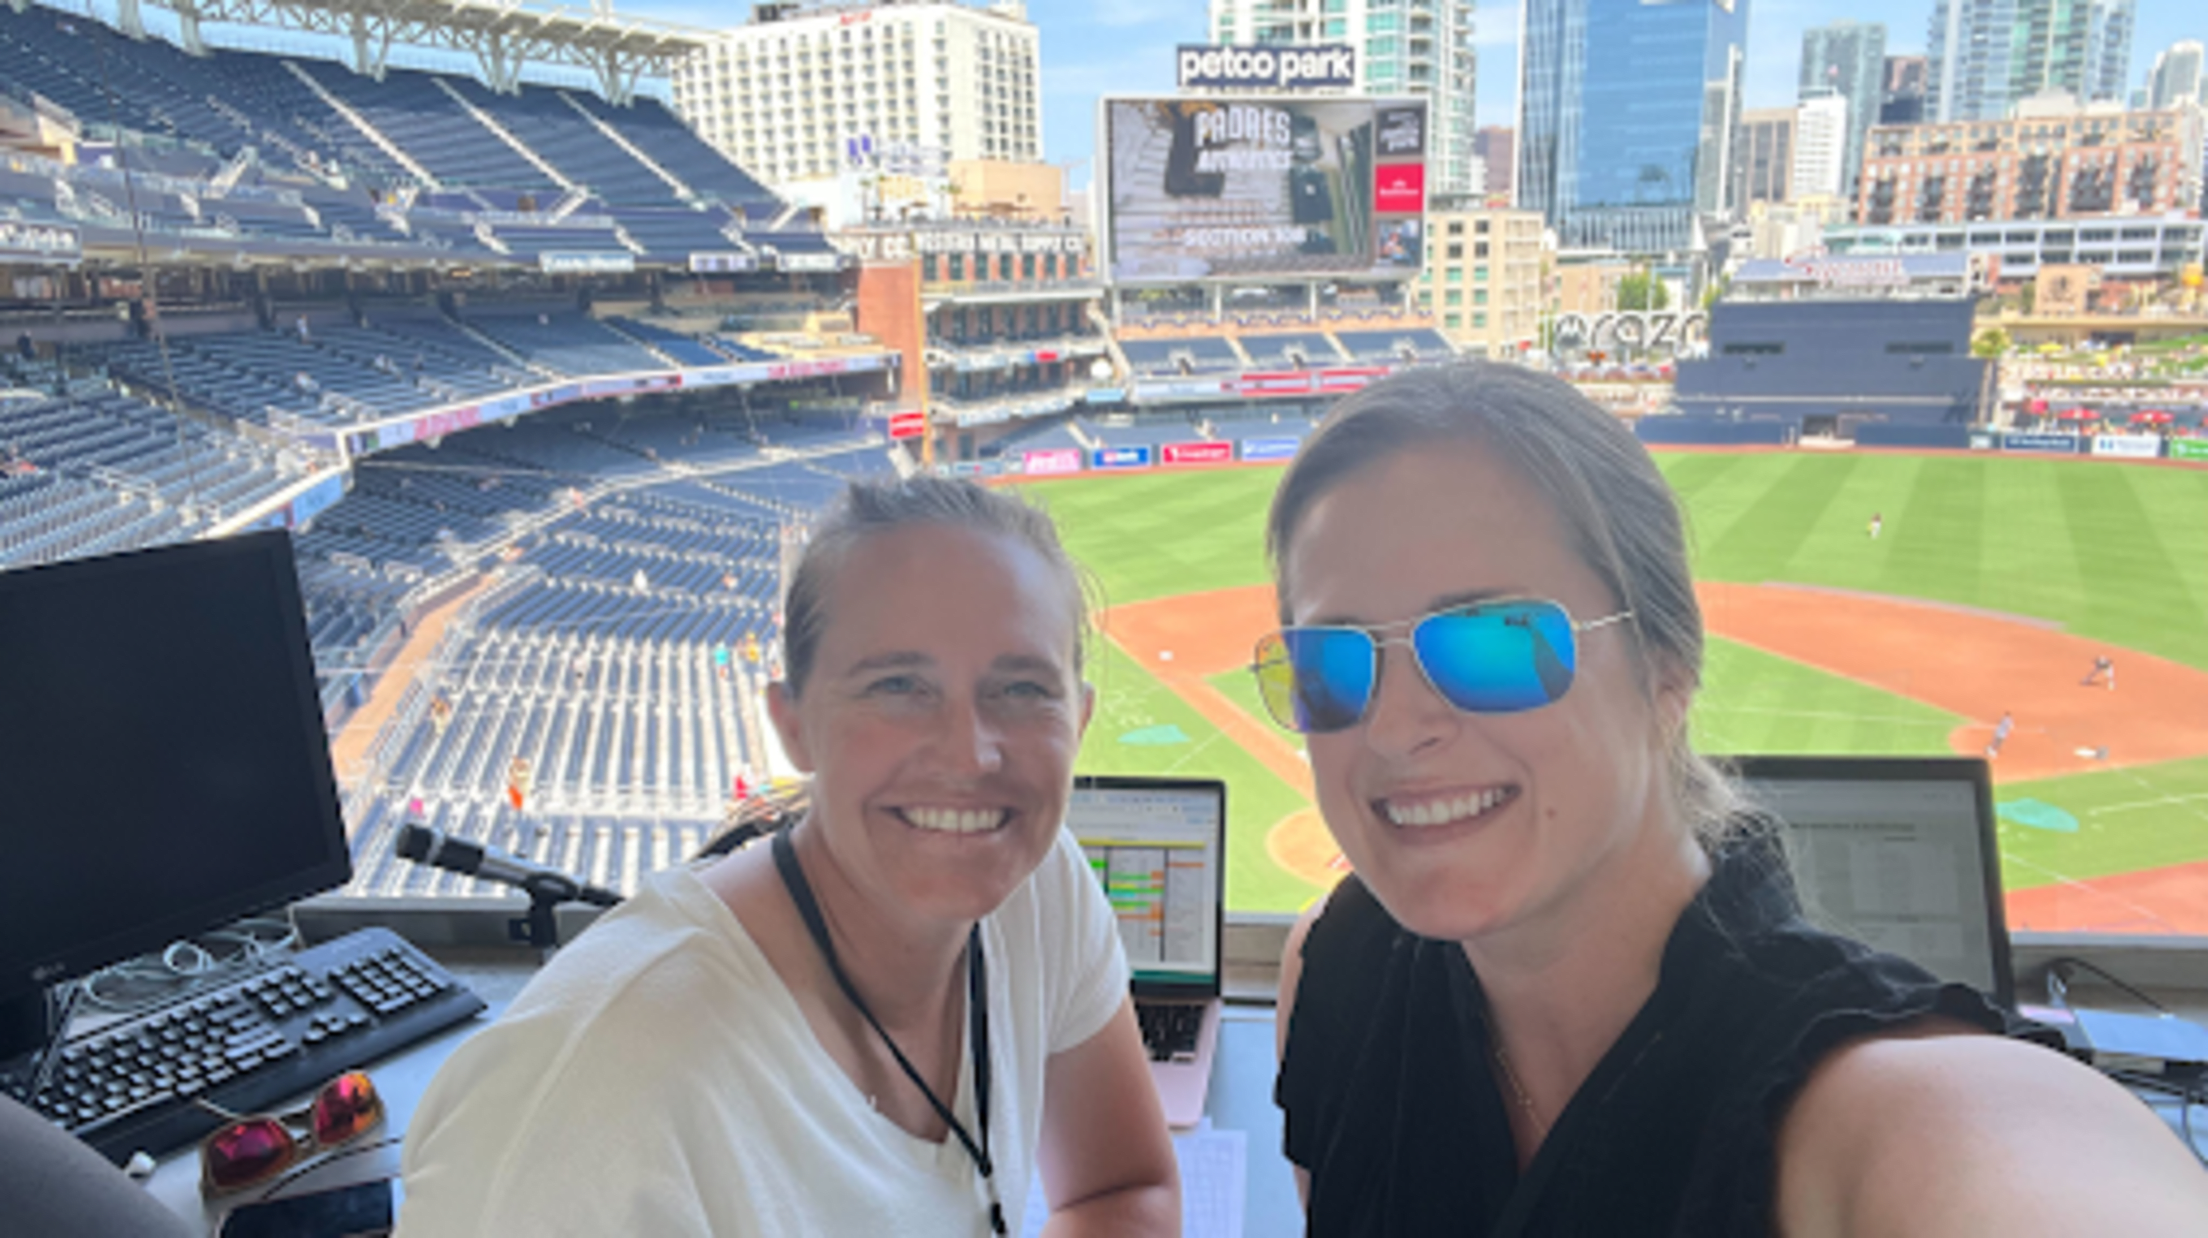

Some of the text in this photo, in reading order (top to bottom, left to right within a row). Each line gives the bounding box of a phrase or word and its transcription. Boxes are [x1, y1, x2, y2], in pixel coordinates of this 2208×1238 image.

[1181, 46, 1353, 86] petco park
[1195, 104, 1290, 147] PADRES
